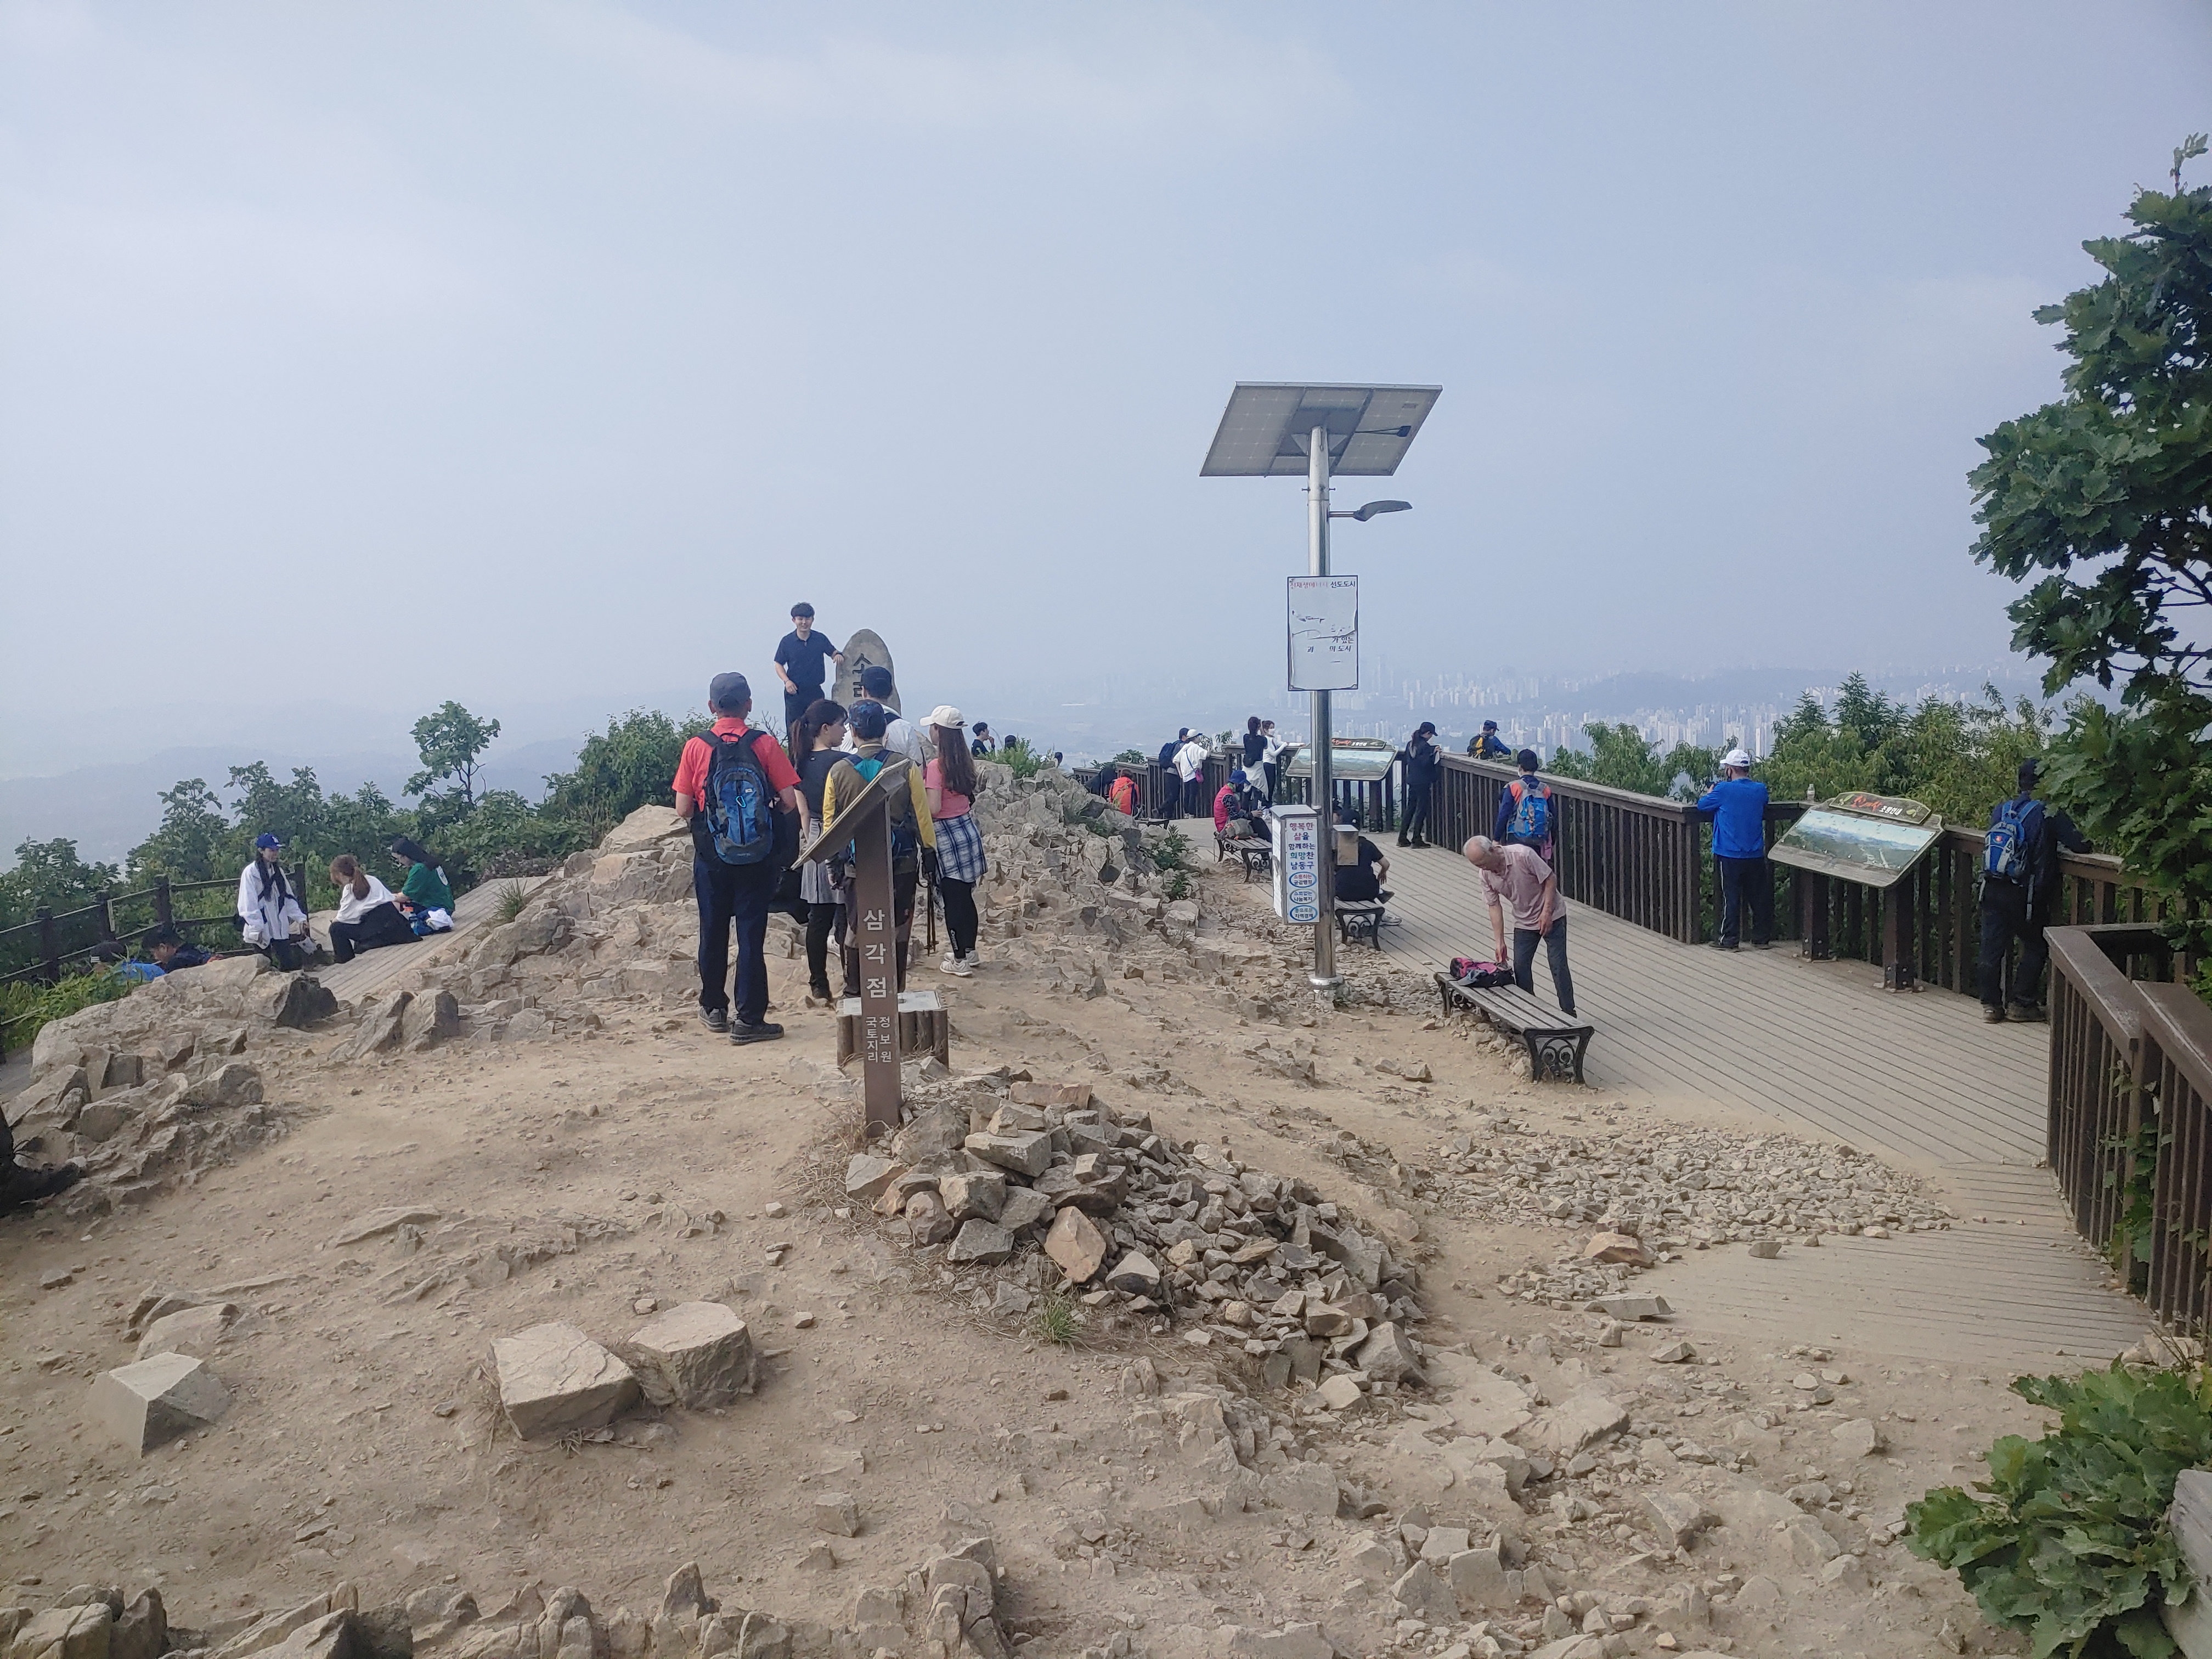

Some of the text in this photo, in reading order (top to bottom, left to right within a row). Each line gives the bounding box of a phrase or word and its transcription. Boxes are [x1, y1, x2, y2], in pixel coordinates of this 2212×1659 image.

[1290, 822, 1314, 831] 행복한
[1294, 832, 1310, 840] 삶을
[1290, 851, 1314, 860] 희망찬
[1290, 861, 1315, 870] 남동구
[863, 909, 887, 998] 삼각점
[865, 1016, 879, 1063] 국토지리
[879, 1015, 892, 1063] 정보원
